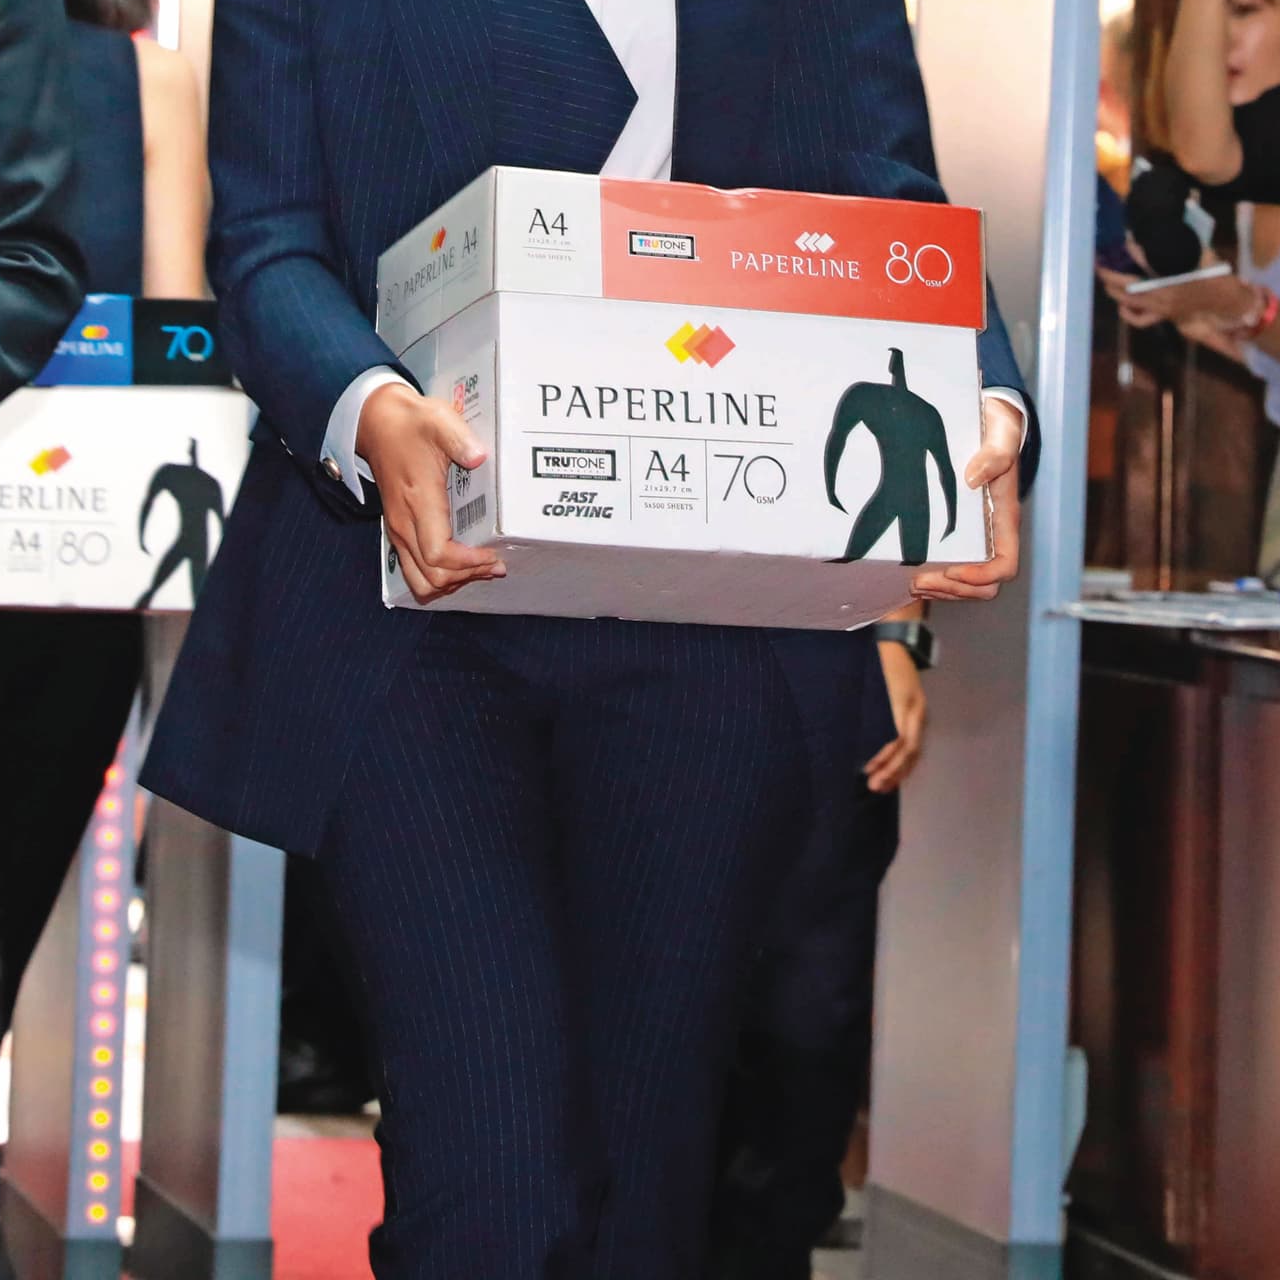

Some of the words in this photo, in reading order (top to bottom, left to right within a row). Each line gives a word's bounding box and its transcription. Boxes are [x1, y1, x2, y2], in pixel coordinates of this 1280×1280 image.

[528, 207, 569, 237] A4
[637, 237, 687, 251] TRUTONE
[403, 245, 455, 299] PAPERLINE
[461, 225, 478, 258] A4
[729, 250, 861, 280] PAPERLINE
[884, 240, 953, 285] 80
[924, 279, 943, 288] GSM
[160, 324, 215, 361] 70
[537, 383, 779, 428] PAPERLINE
[543, 455, 607, 470] TRUTONE
[644, 449, 691, 482] A4
[713, 454, 787, 502] 70
[541, 503, 614, 519] COPYING
[558, 490, 598, 504] FAST
[667, 502, 694, 511] SHEETS
[755, 495, 776, 505] GSM
[9, 529, 42, 553] A4
[58, 530, 111, 566] 80
